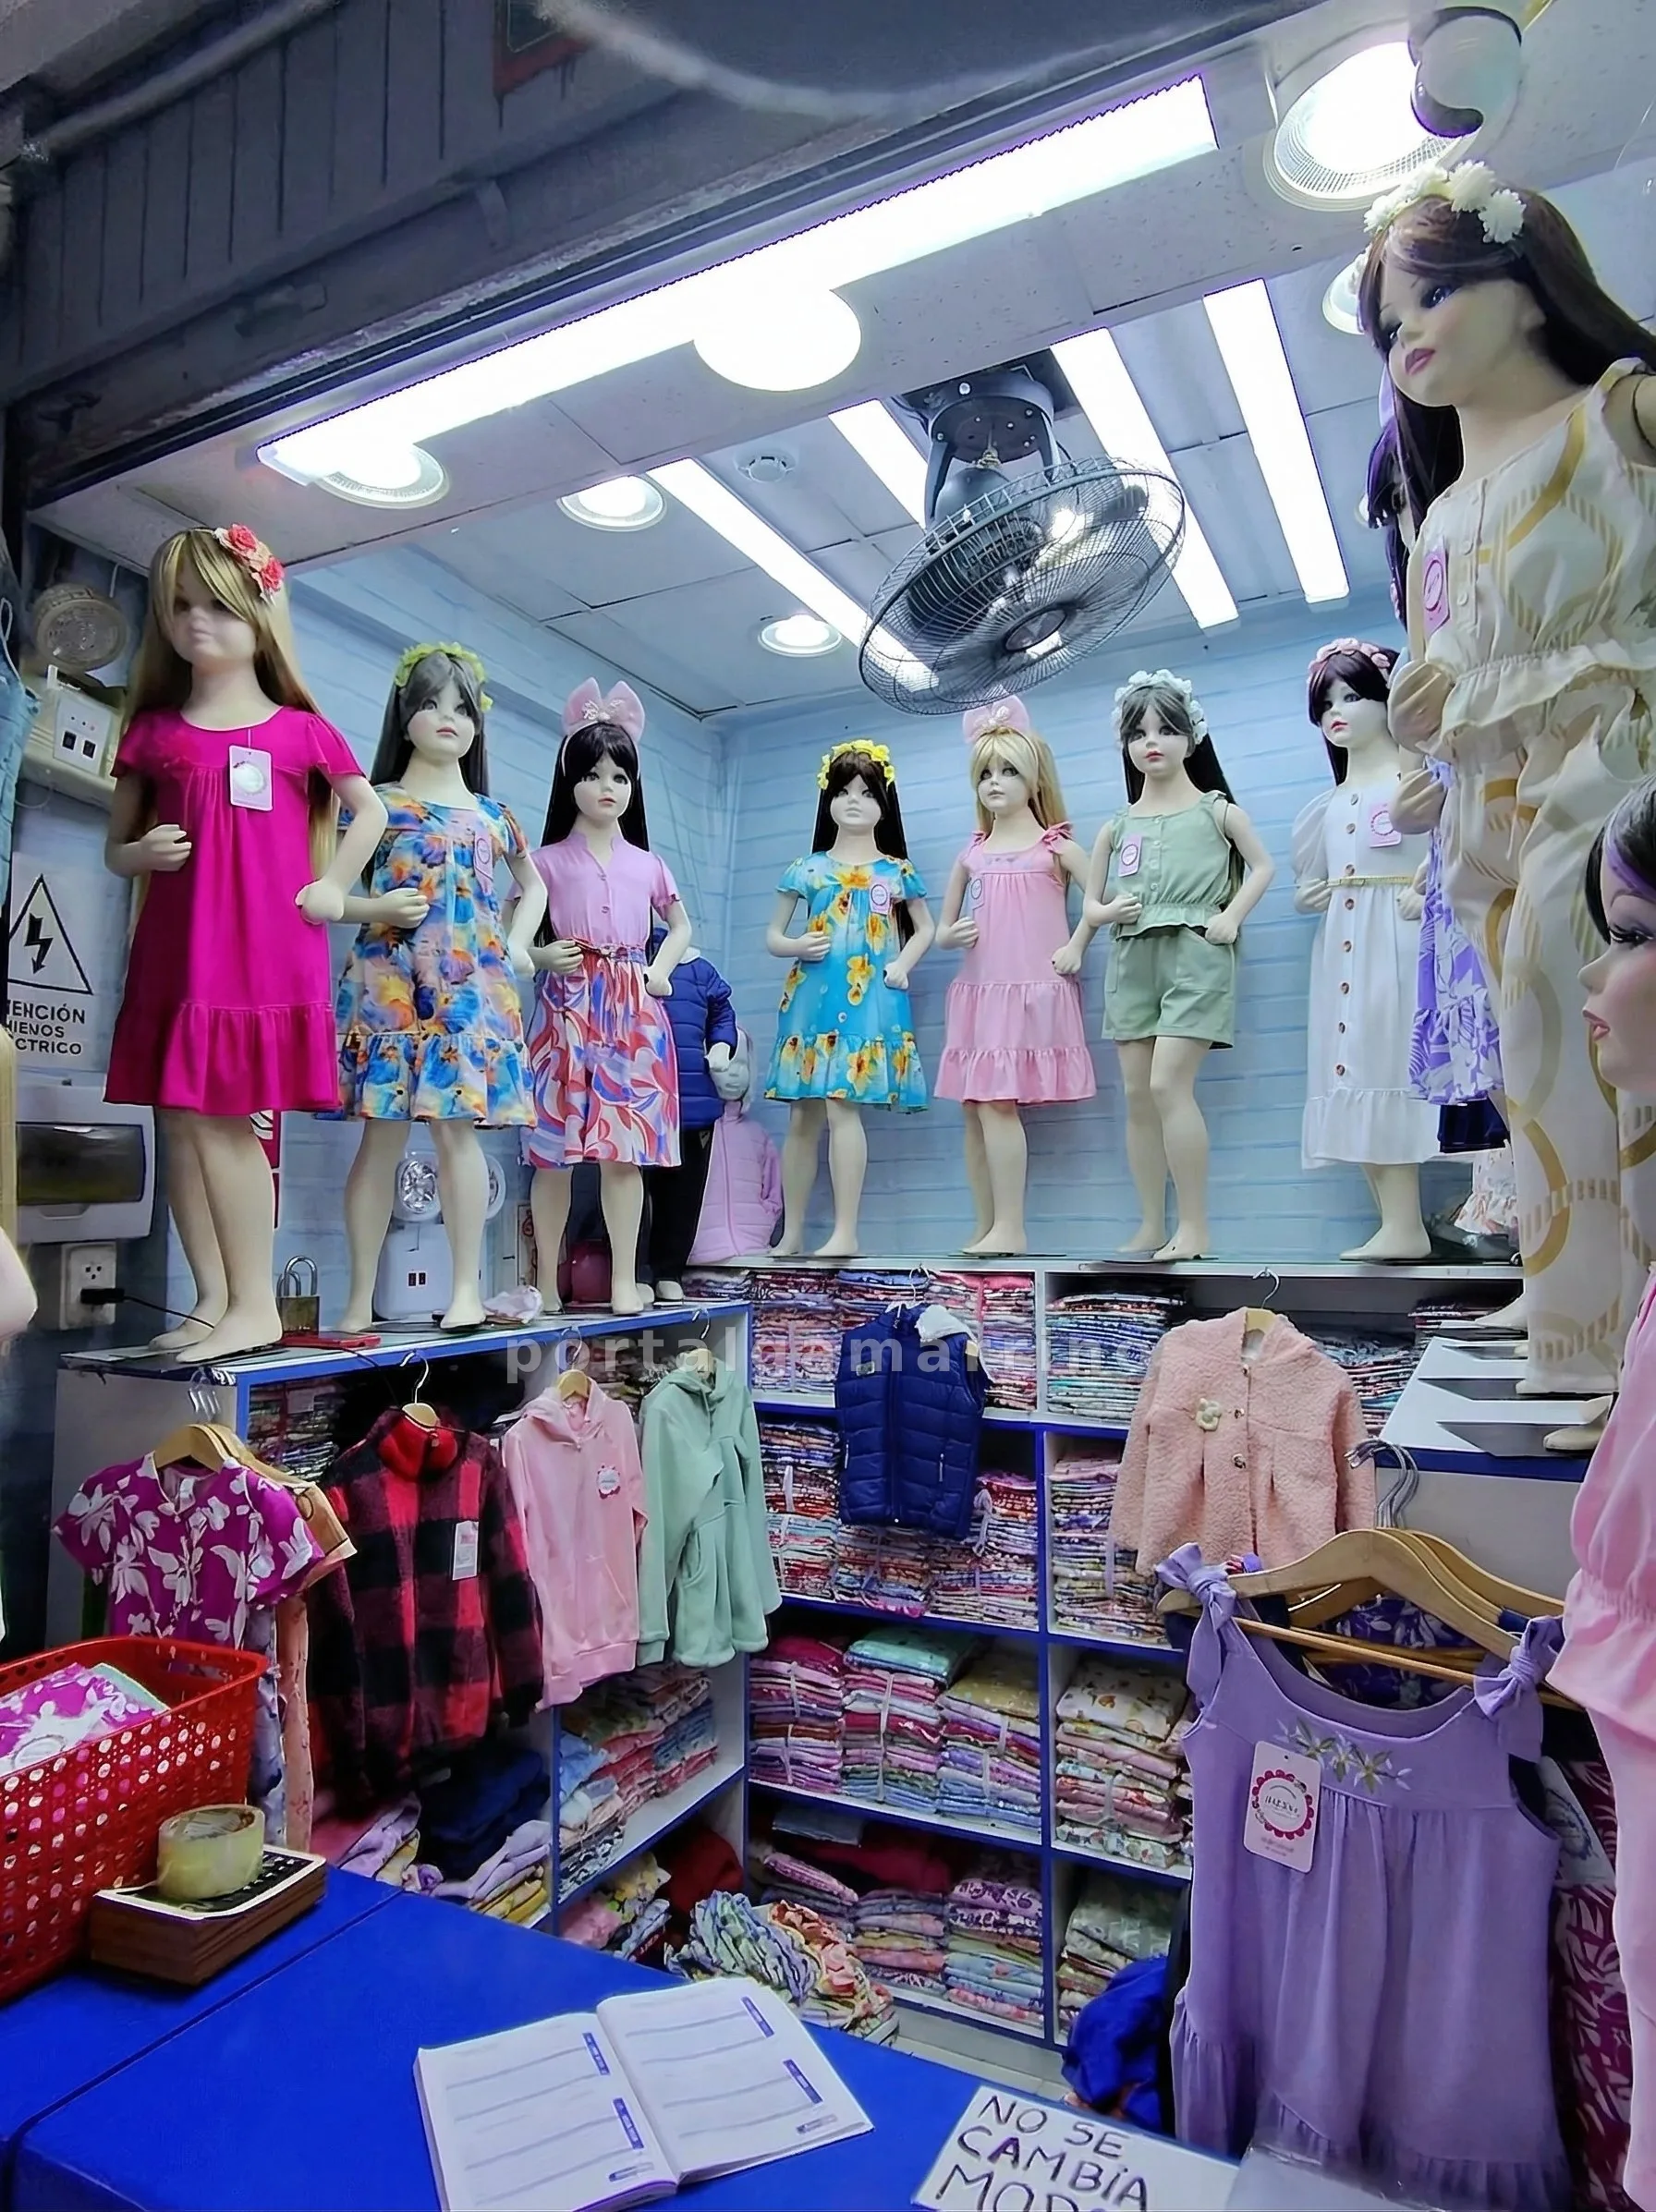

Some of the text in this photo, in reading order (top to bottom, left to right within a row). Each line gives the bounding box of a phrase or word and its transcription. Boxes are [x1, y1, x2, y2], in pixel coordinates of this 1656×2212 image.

[978, 2095, 1129, 2158] NO SE
[935, 2164, 1106, 2212] MOD
